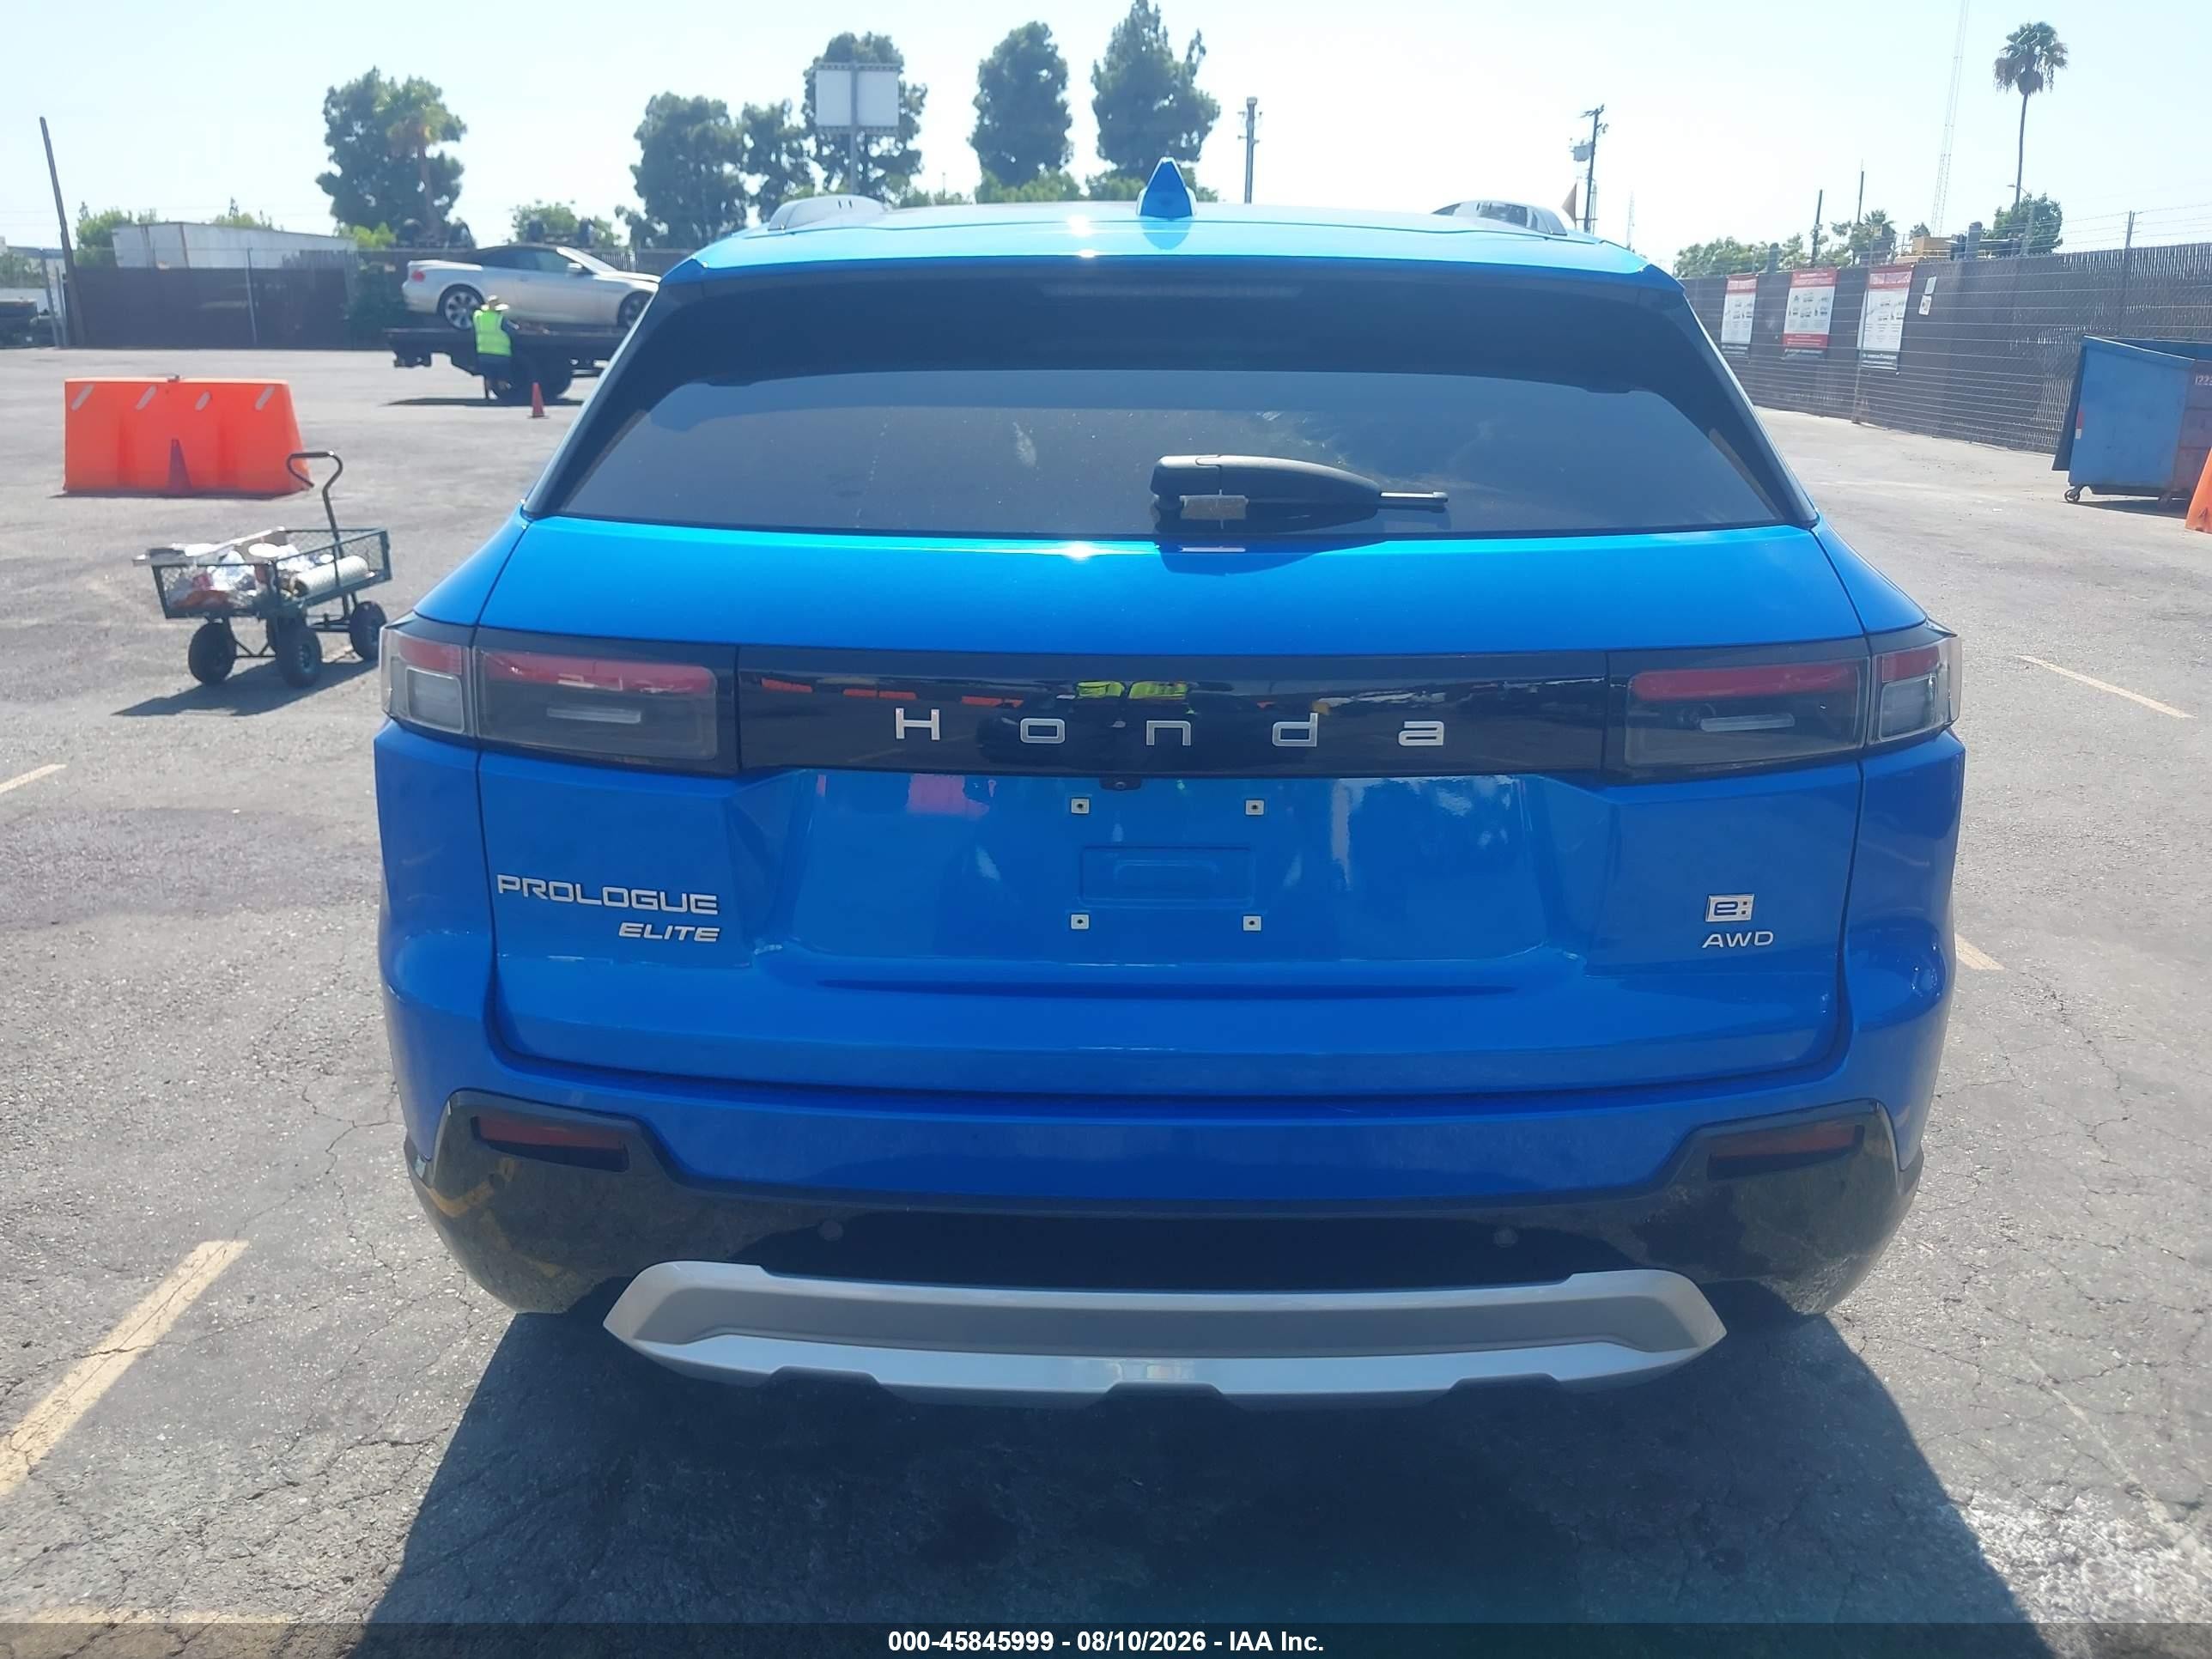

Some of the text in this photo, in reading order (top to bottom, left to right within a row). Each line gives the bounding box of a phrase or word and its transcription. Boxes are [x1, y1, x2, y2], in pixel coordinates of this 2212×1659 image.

[895, 707, 1445, 748] Honda
[496, 874, 719, 915] PROLOGUE
[618, 921, 720, 942] ELITE
[1702, 931, 1774, 949] AWD
